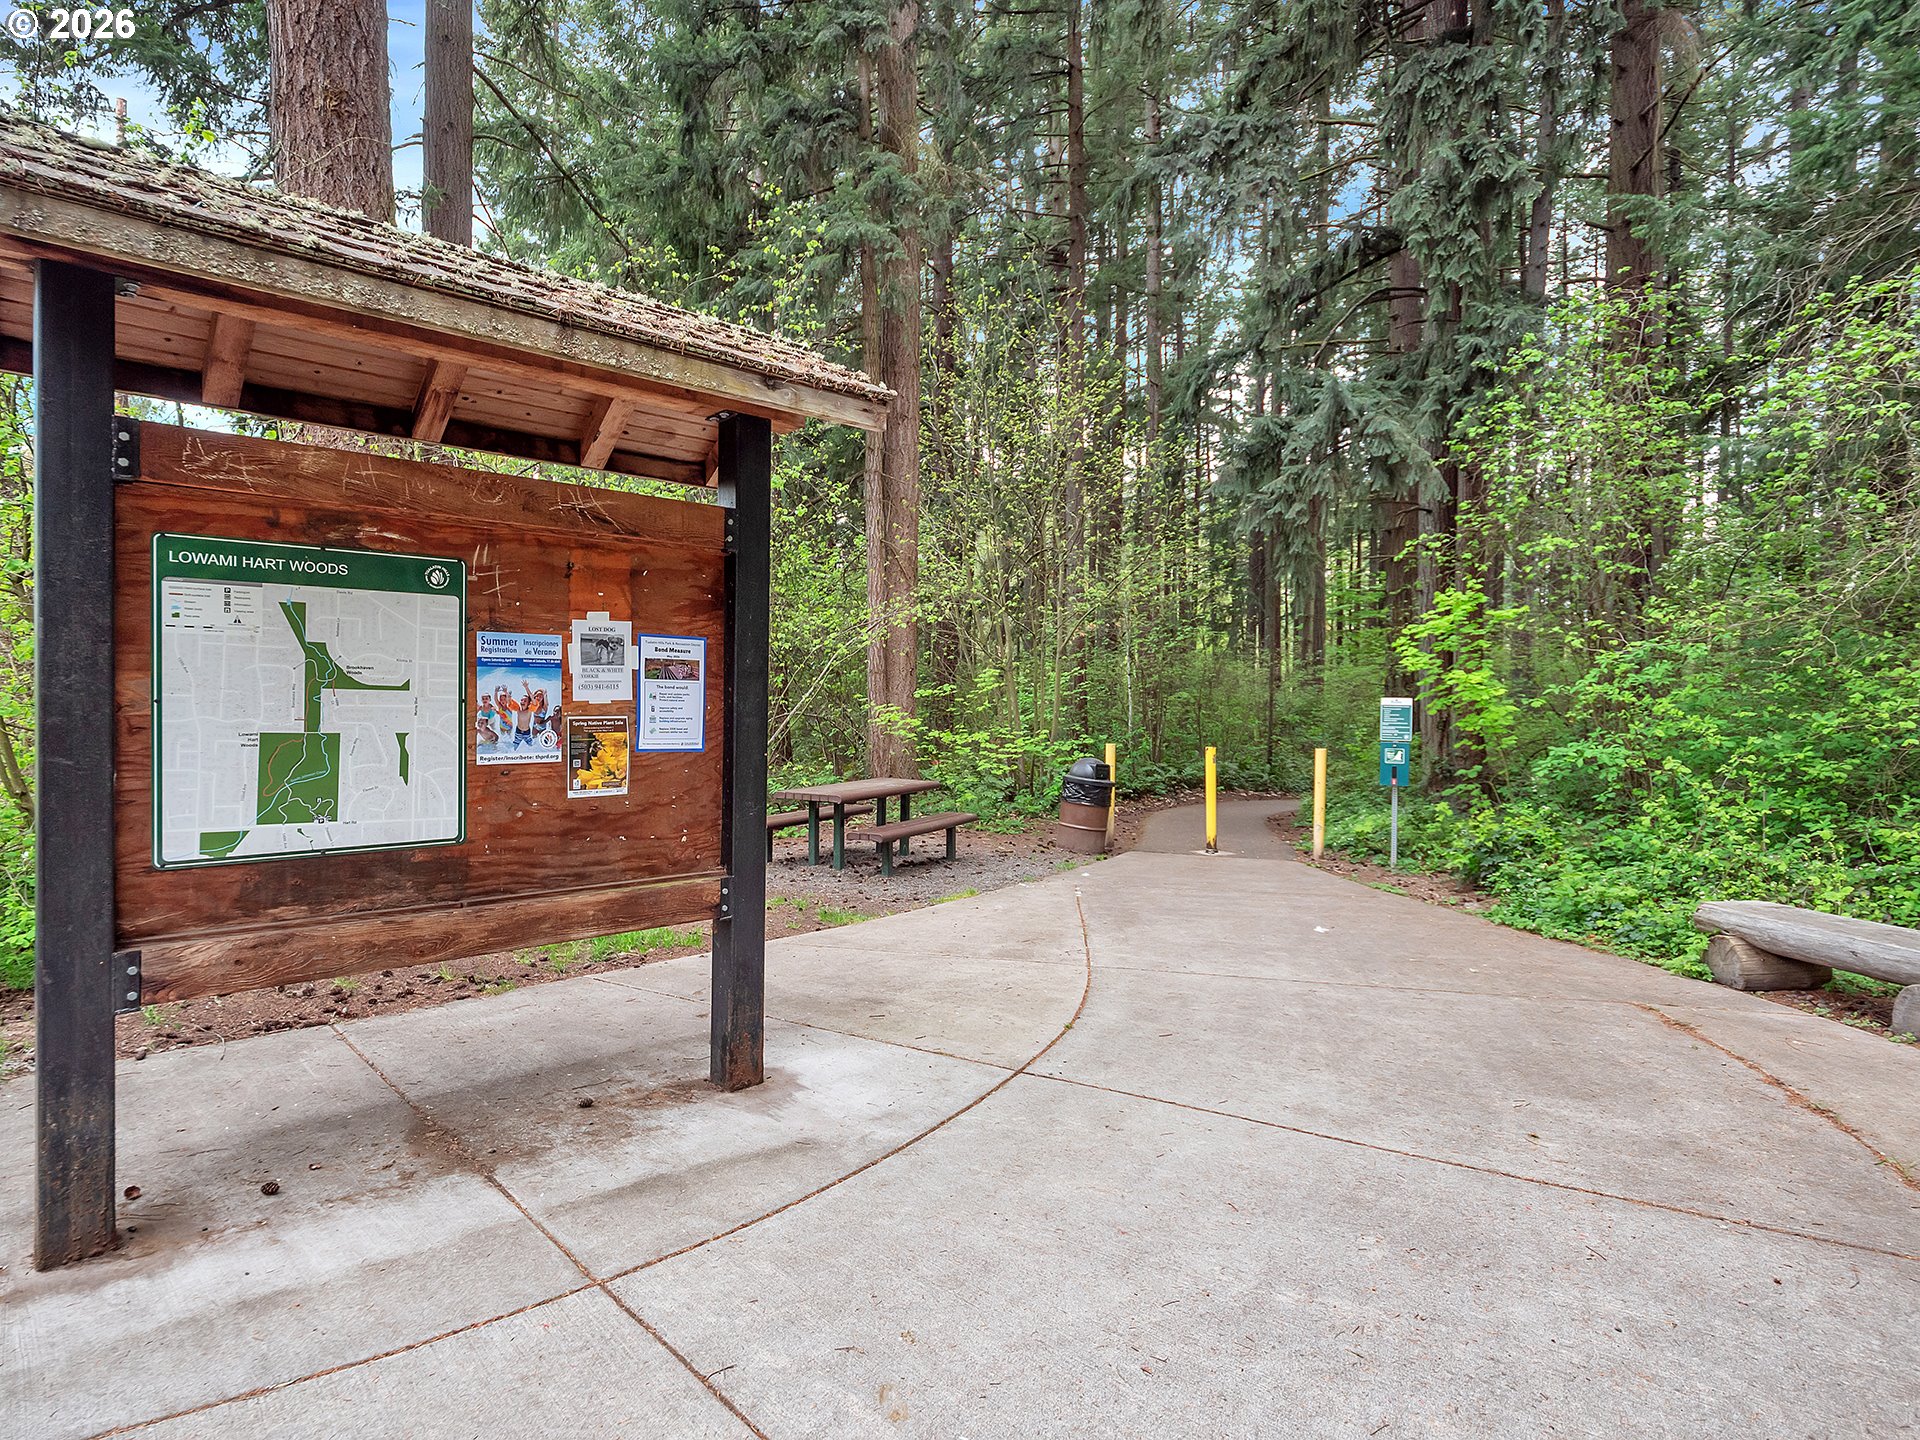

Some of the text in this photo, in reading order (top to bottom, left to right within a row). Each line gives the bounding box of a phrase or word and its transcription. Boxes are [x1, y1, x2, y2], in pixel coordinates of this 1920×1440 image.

[169, 550, 349, 576] LOWAMI HART WOODS
[480, 636, 518, 646] Summer
[523, 638, 559, 648] Inscripciones
[480, 646, 518, 654] Registration
[533, 648, 556, 656] Verano
